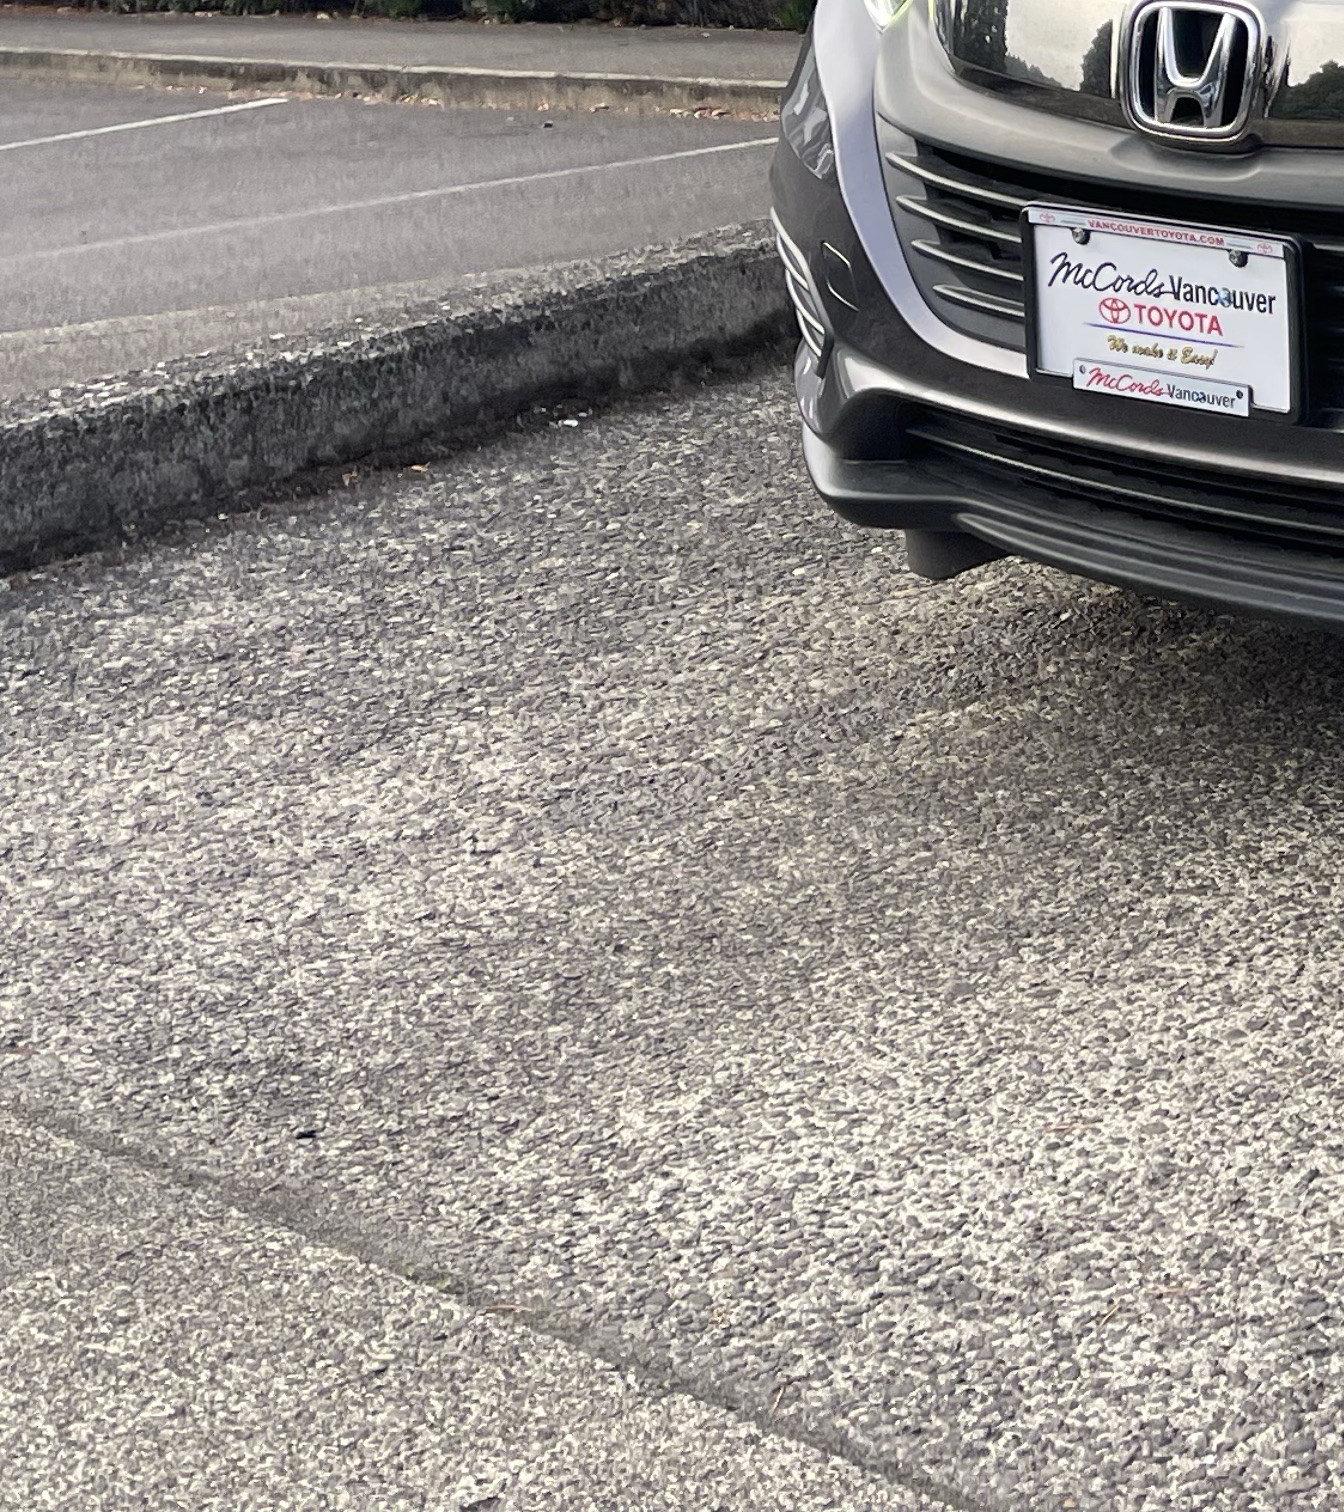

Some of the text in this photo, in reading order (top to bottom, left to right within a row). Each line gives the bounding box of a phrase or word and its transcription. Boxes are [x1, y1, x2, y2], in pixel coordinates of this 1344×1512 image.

[1087, 219, 1226, 247] VANCOUVERTOYOTA.COM
[1133, 303, 1225, 337] TOYOTA
[1131, 342, 1164, 359] make
